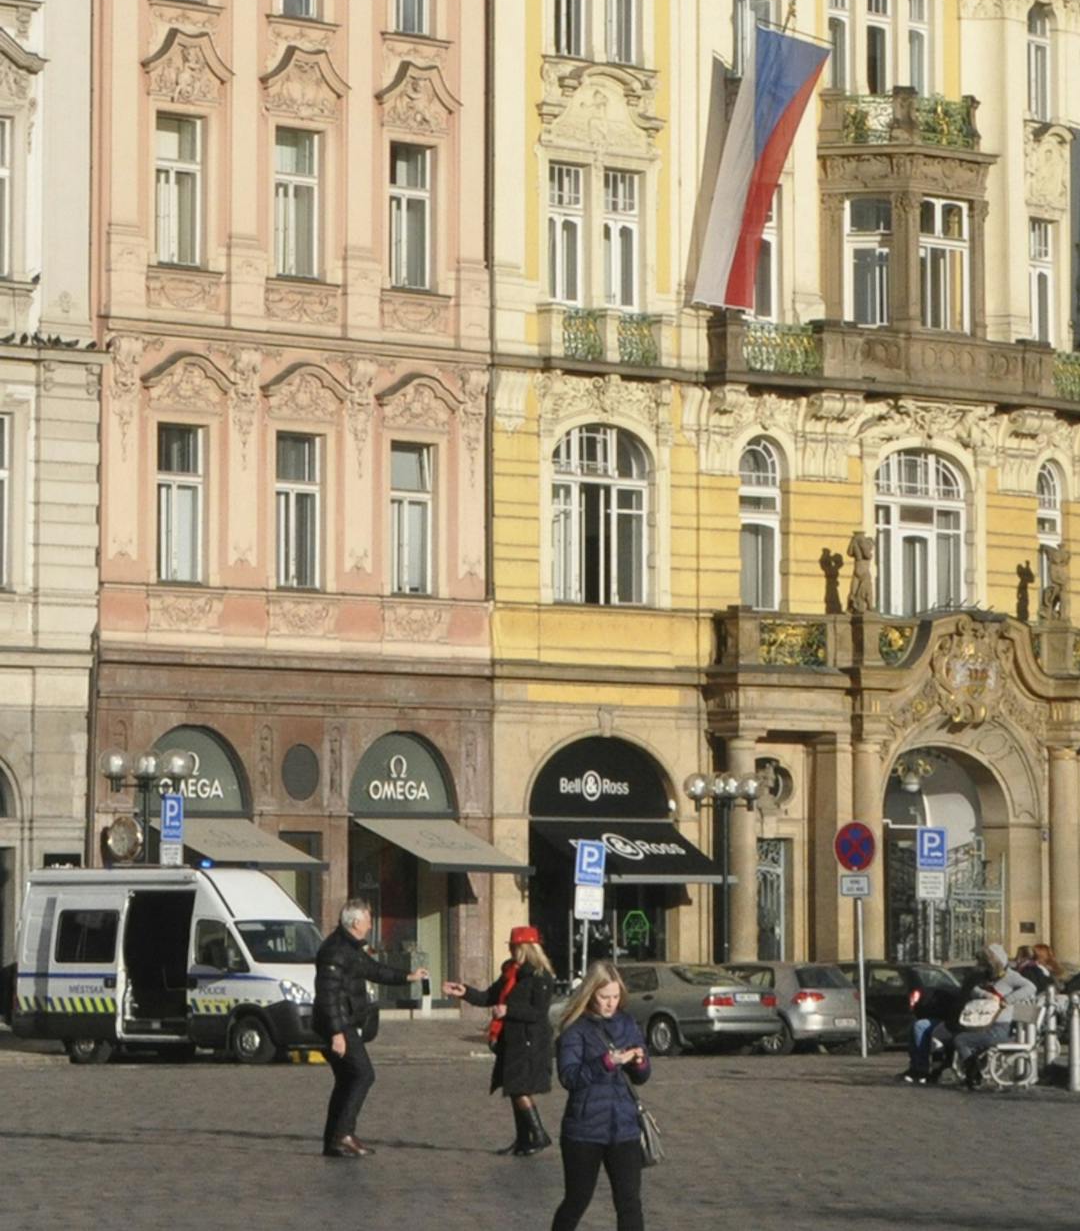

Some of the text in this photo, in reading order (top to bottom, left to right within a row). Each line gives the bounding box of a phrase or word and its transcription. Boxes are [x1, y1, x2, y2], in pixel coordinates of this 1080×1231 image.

[368, 780, 430, 800] OMEGA
[559, 777, 582, 794] Bell
[602, 778, 630, 796] Ross
[165, 799, 179, 826] P
[635, 839, 686, 856] Ross
[923, 832, 941, 857] P
[581, 845, 600, 872] P
